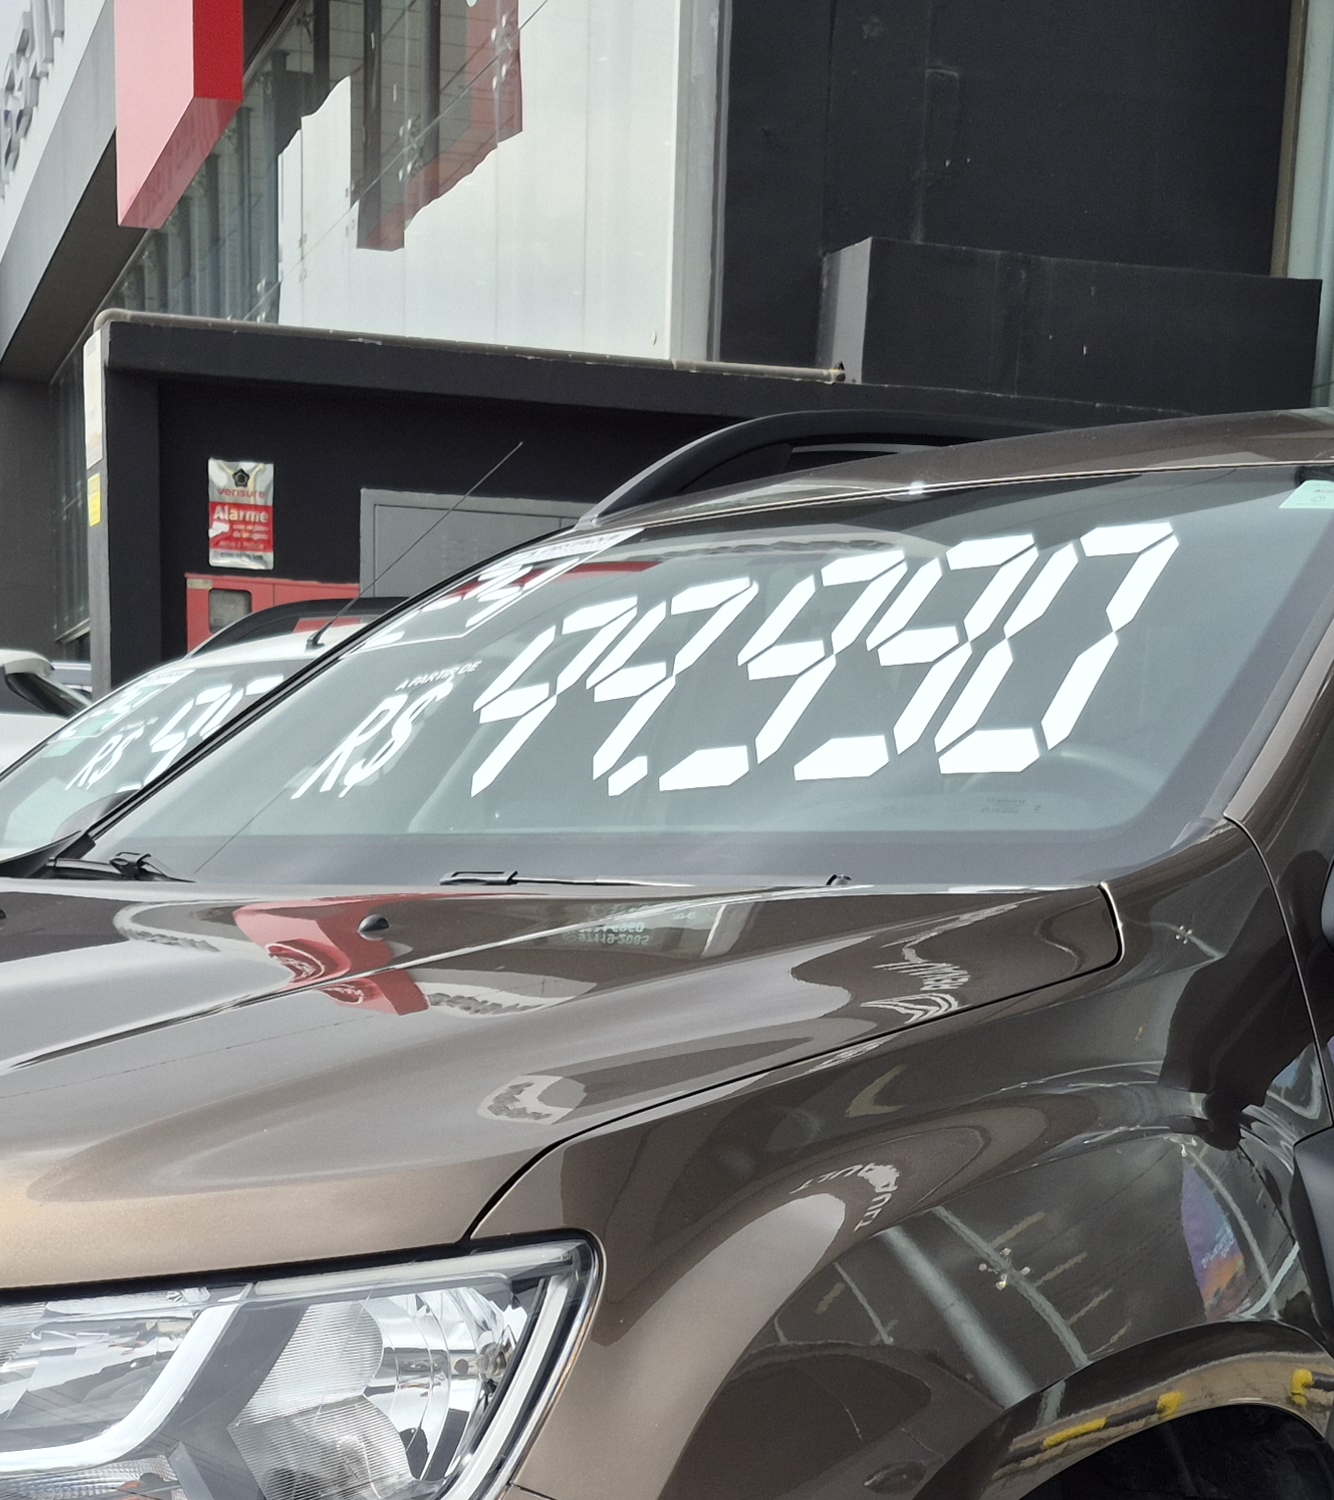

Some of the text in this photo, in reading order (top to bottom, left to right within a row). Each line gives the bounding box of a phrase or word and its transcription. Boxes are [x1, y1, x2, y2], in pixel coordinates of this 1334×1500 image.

[216, 487, 266, 499] verisure
[213, 505, 269, 523] Alarme
[395, 660, 483, 692] A PARTIR DE
[290, 680, 454, 800] R$
[63, 725, 146, 791] R$
